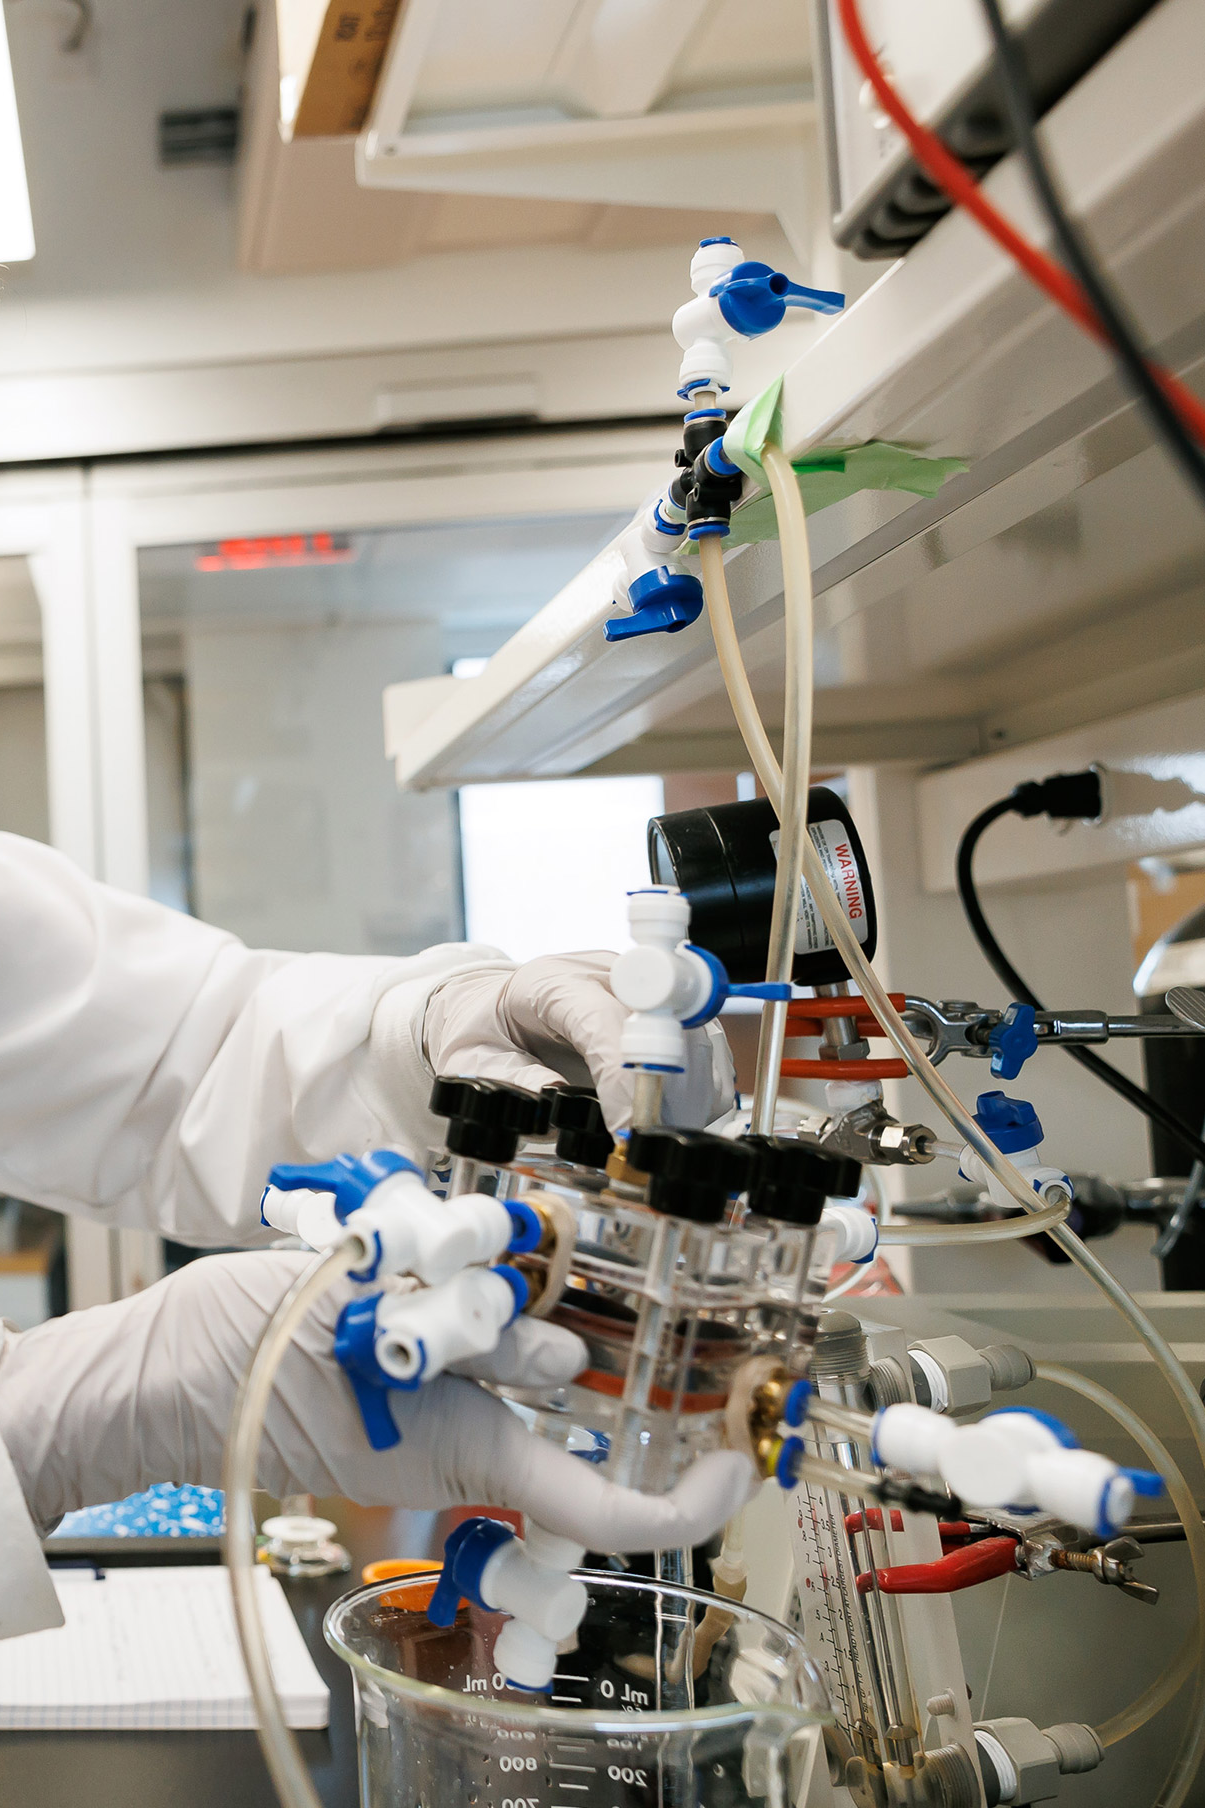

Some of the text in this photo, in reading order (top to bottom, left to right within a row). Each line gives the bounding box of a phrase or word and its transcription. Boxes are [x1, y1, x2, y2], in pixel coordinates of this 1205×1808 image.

[835, 843, 863, 919] WARNING
[829, 1513, 841, 1556] DIAMETER
[837, 1559, 848, 1597] LARGEST
